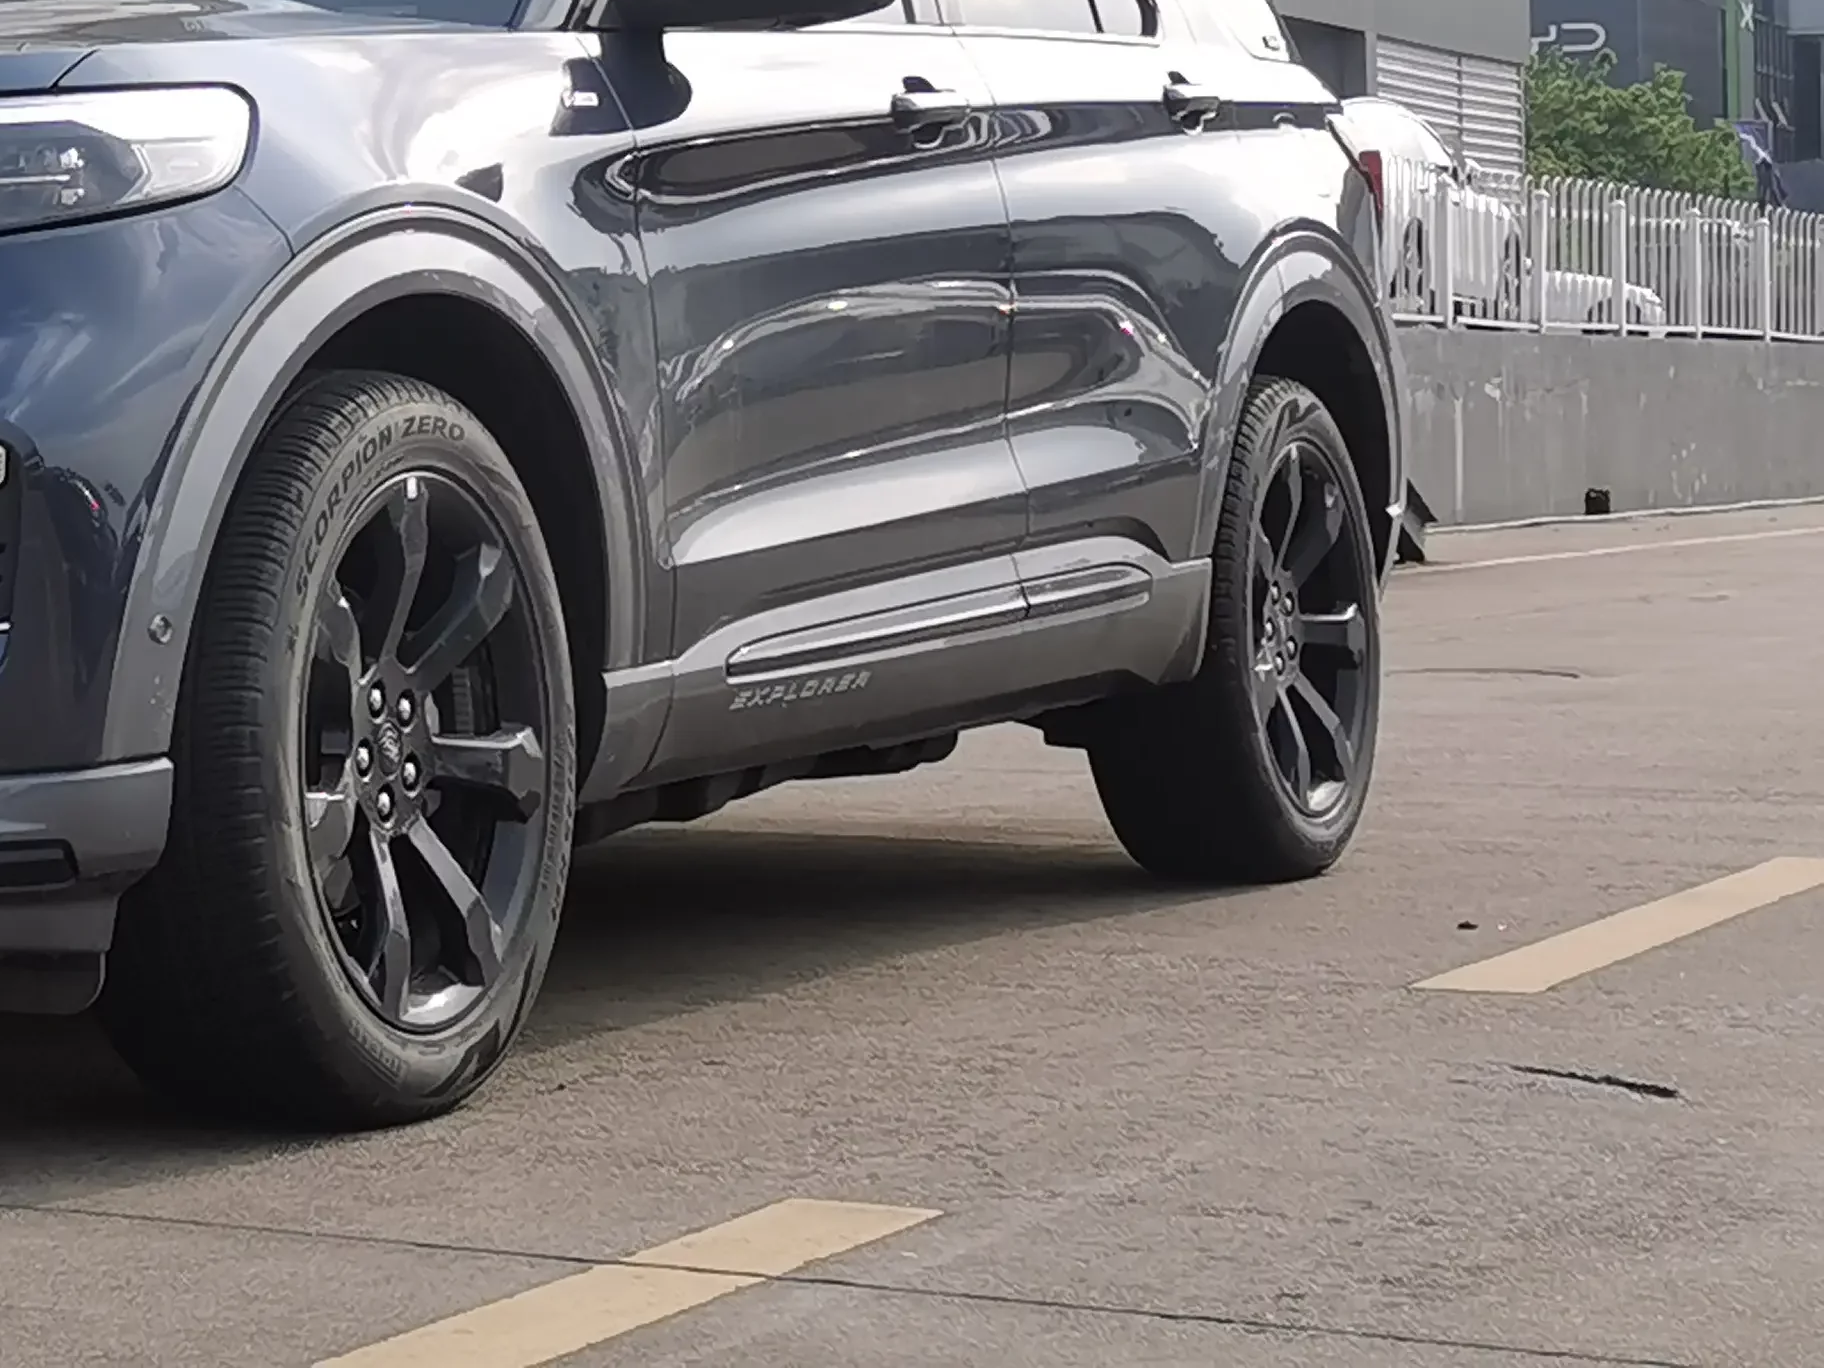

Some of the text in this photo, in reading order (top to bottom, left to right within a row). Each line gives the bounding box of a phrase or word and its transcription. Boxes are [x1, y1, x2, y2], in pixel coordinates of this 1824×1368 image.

[296, 415, 465, 597] SCORPION ZERO
[729, 671, 872, 710] EXPLORER
